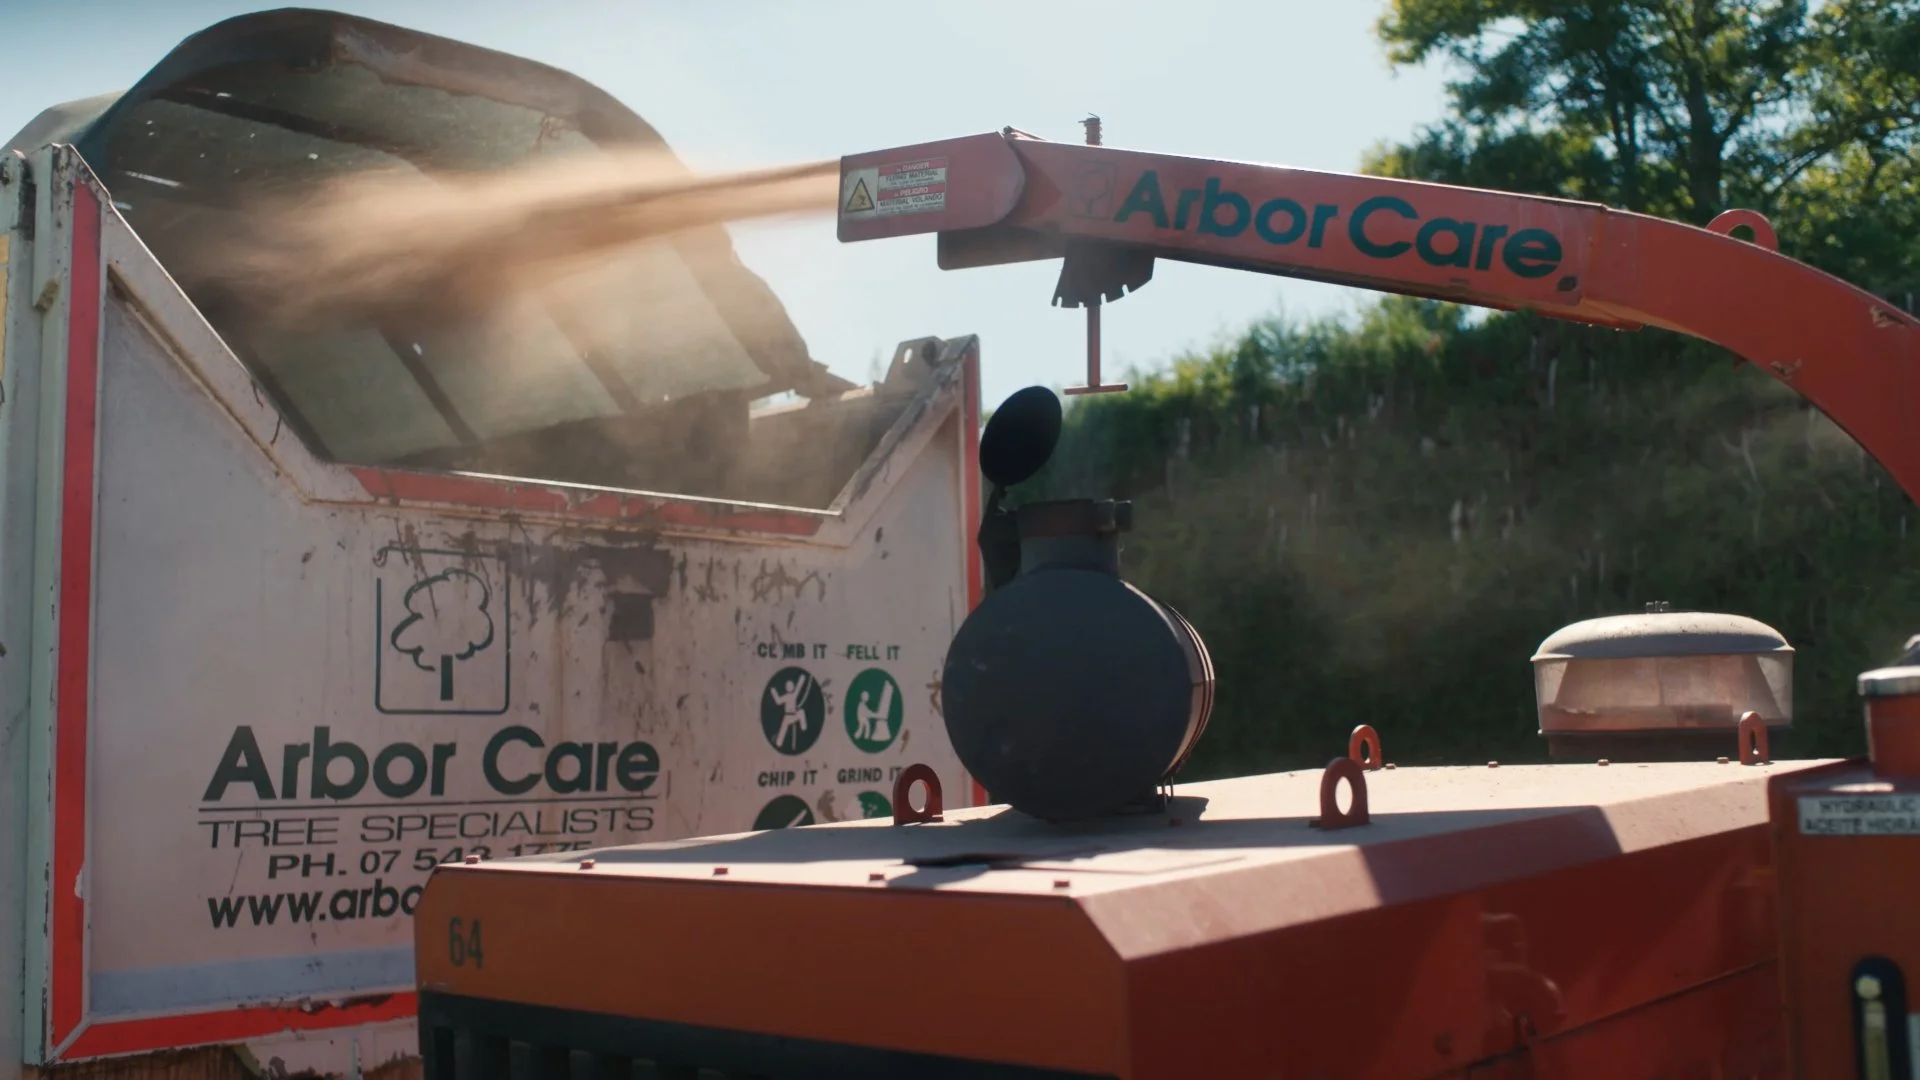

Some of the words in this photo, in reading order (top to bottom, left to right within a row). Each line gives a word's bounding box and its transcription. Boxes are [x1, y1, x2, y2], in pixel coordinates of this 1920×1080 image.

[902, 161, 930, 171] DANGER
[900, 187, 929, 197] PELIGRO
[1114, 170, 1339, 248] Arbor
[1348, 195, 1563, 278] Care
[812, 643, 827, 659] IT
[846, 643, 880, 660] FELL
[887, 645, 900, 660] IT
[202, 725, 456, 801] Arbor
[482, 725, 660, 796] Care
[757, 770, 796, 788] CHIP
[803, 770, 818, 785] IT
[837, 767, 882, 784] GRIND
[198, 817, 339, 849] TREE
[360, 806, 654, 843] SPECIALISTS
[268, 853, 347, 879] PH.
[360, 850, 401, 874] 07
[449, 916, 483, 969] 64
